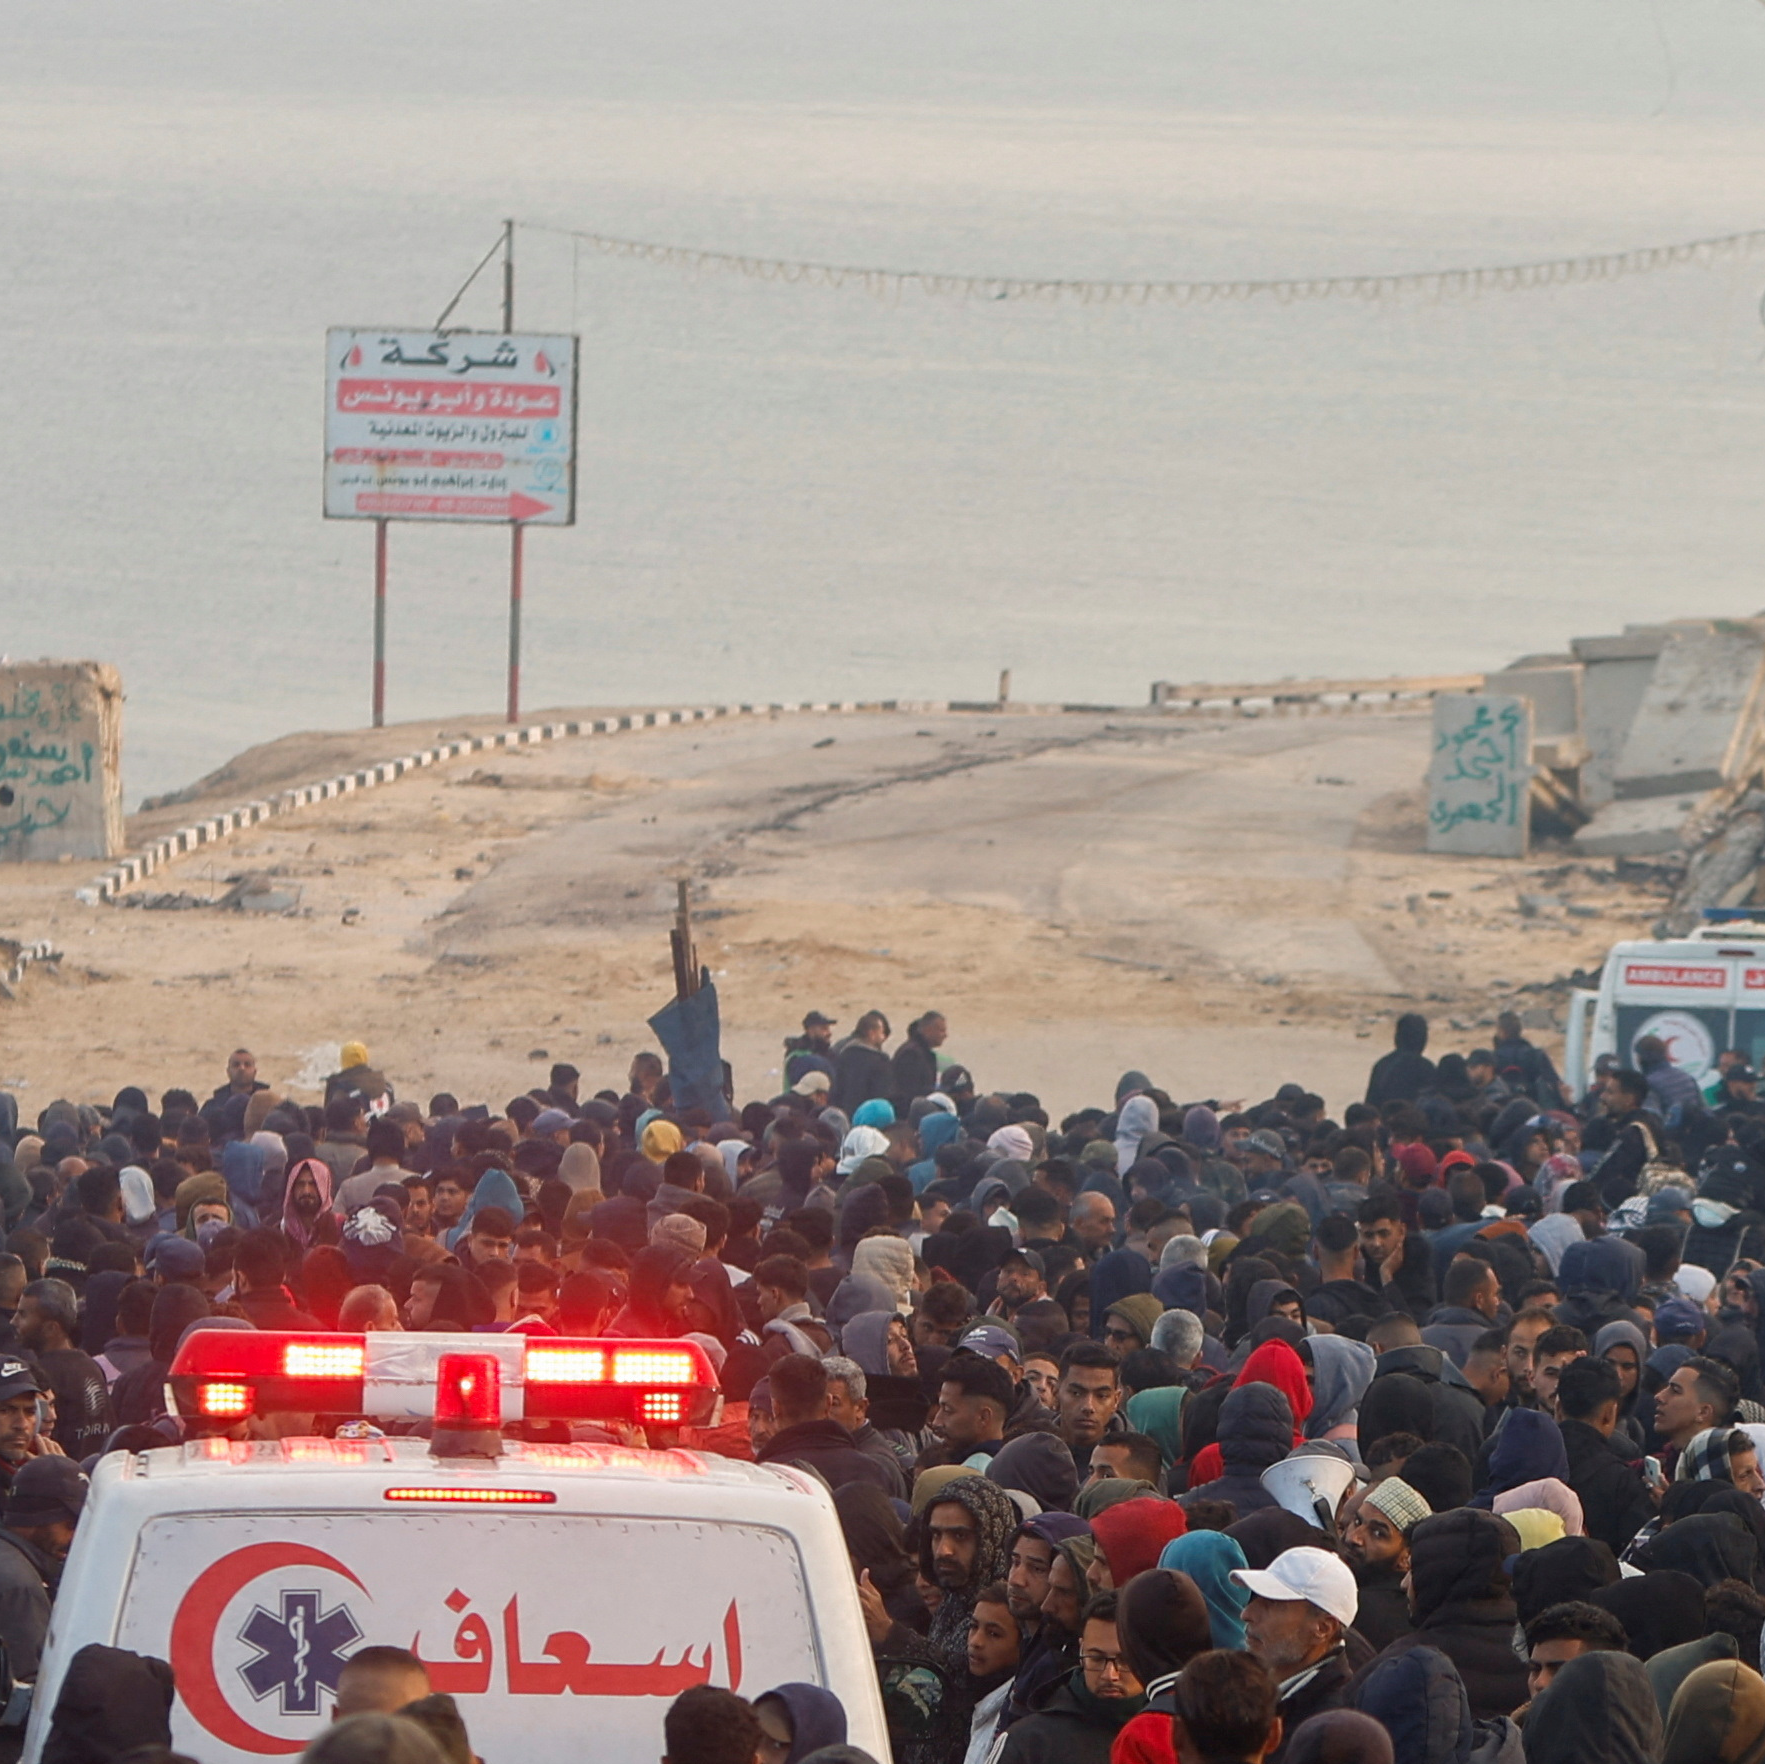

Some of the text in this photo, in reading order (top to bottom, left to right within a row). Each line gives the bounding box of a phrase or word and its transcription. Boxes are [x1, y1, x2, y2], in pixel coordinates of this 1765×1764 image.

[379, 338, 518, 374] شركة
[1629, 968, 1723, 986] AMBULANCE
[410, 1586, 742, 1699] اسعاف
